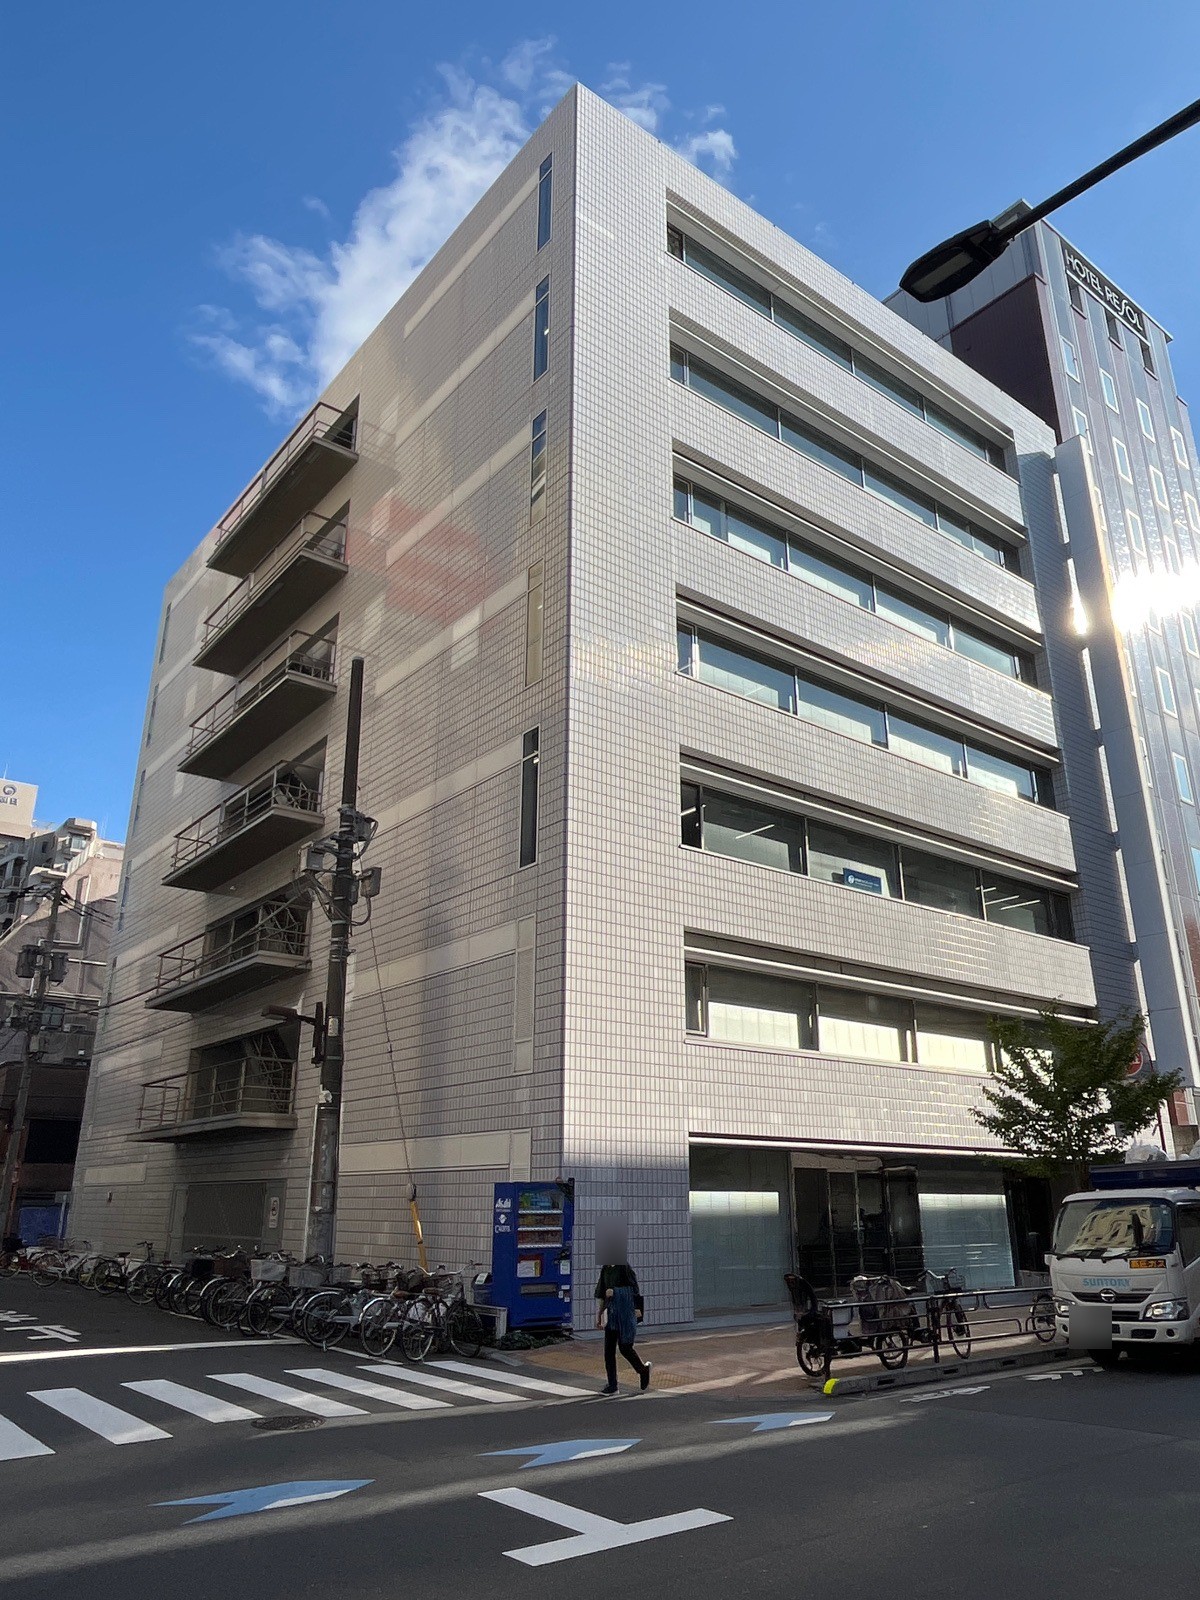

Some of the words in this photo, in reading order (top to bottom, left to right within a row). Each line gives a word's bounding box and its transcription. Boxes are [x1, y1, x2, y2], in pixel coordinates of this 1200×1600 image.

[1065, 250, 1104, 296] HOTEL
[1104, 285, 1143, 331] RESOL
[495, 1197, 512, 1208] Asahi
[1083, 1277, 1131, 1287] SUNTORY
